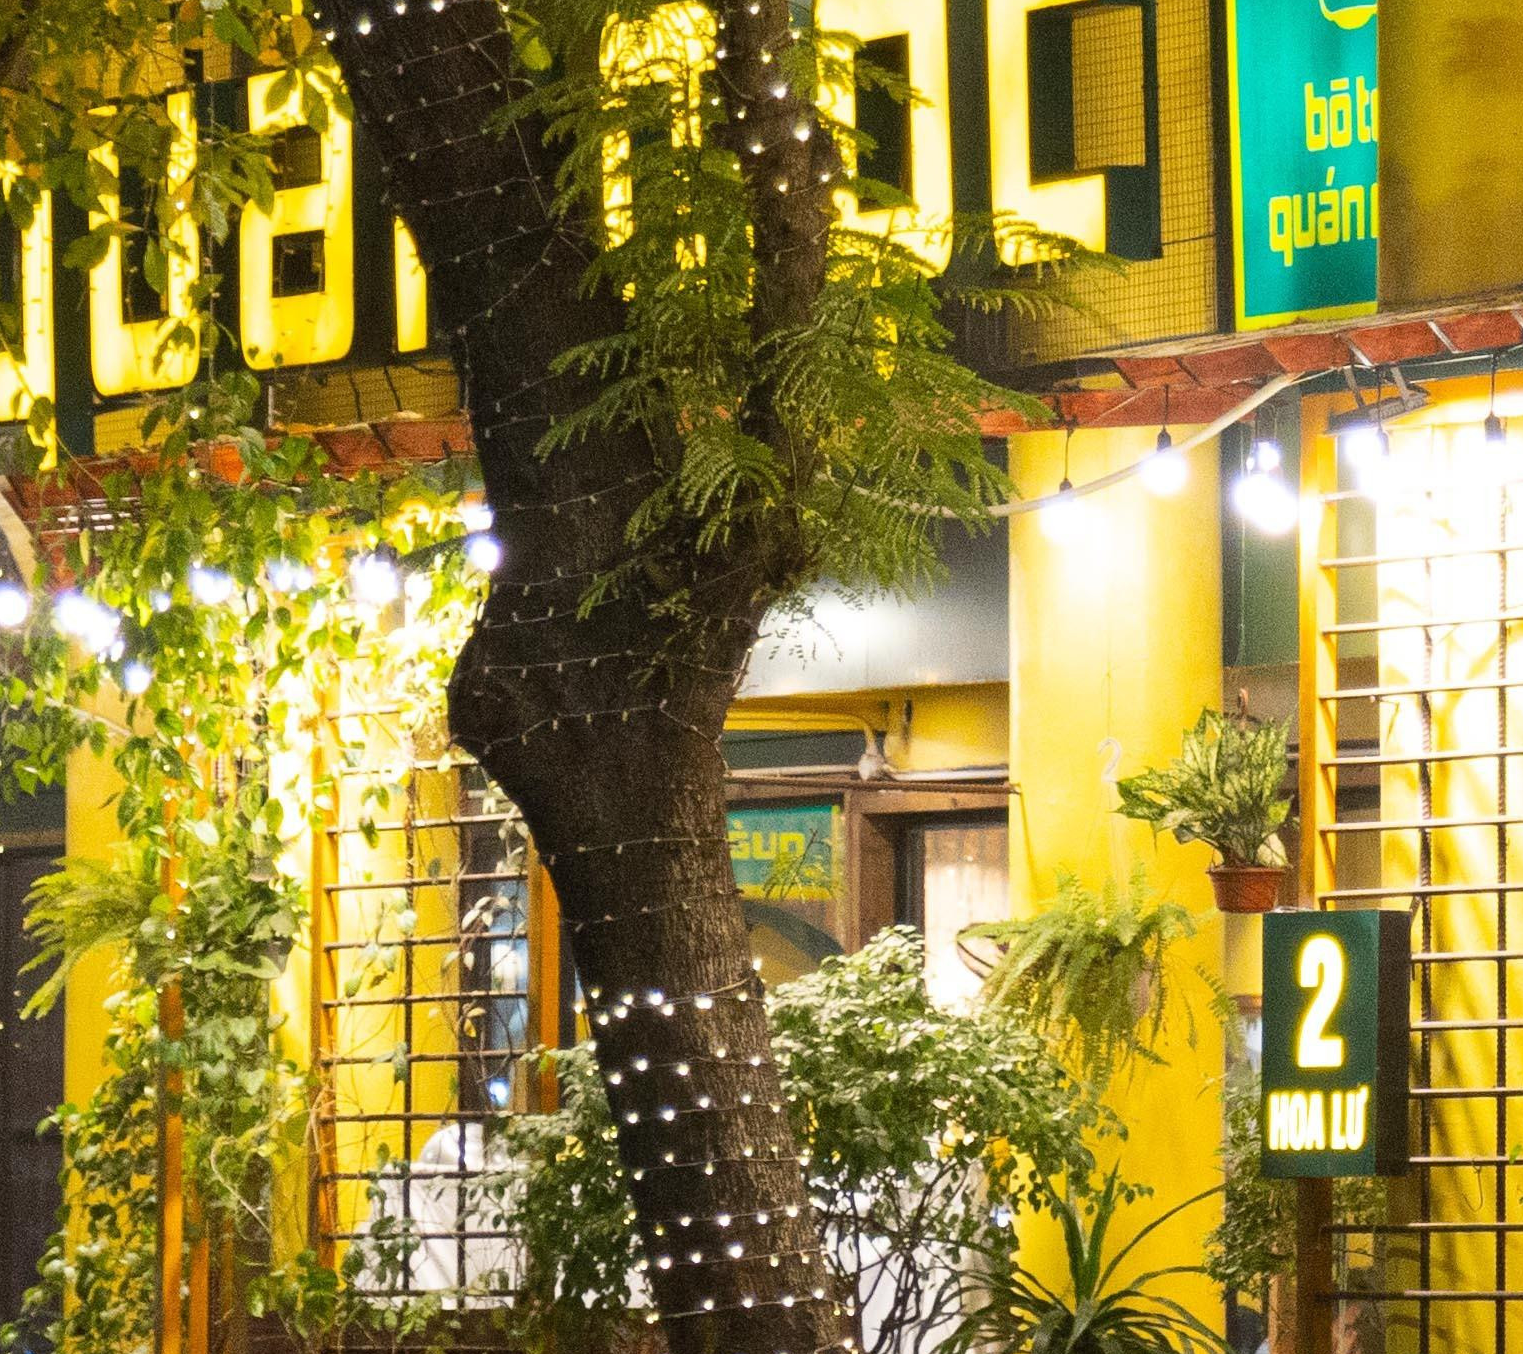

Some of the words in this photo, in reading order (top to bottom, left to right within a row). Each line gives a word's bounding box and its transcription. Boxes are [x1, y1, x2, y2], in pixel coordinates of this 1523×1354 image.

[1296, 933, 1346, 1070] 2
[1268, 1090, 1326, 1151] HOA
[1329, 1084, 1369, 1151] LƯ
